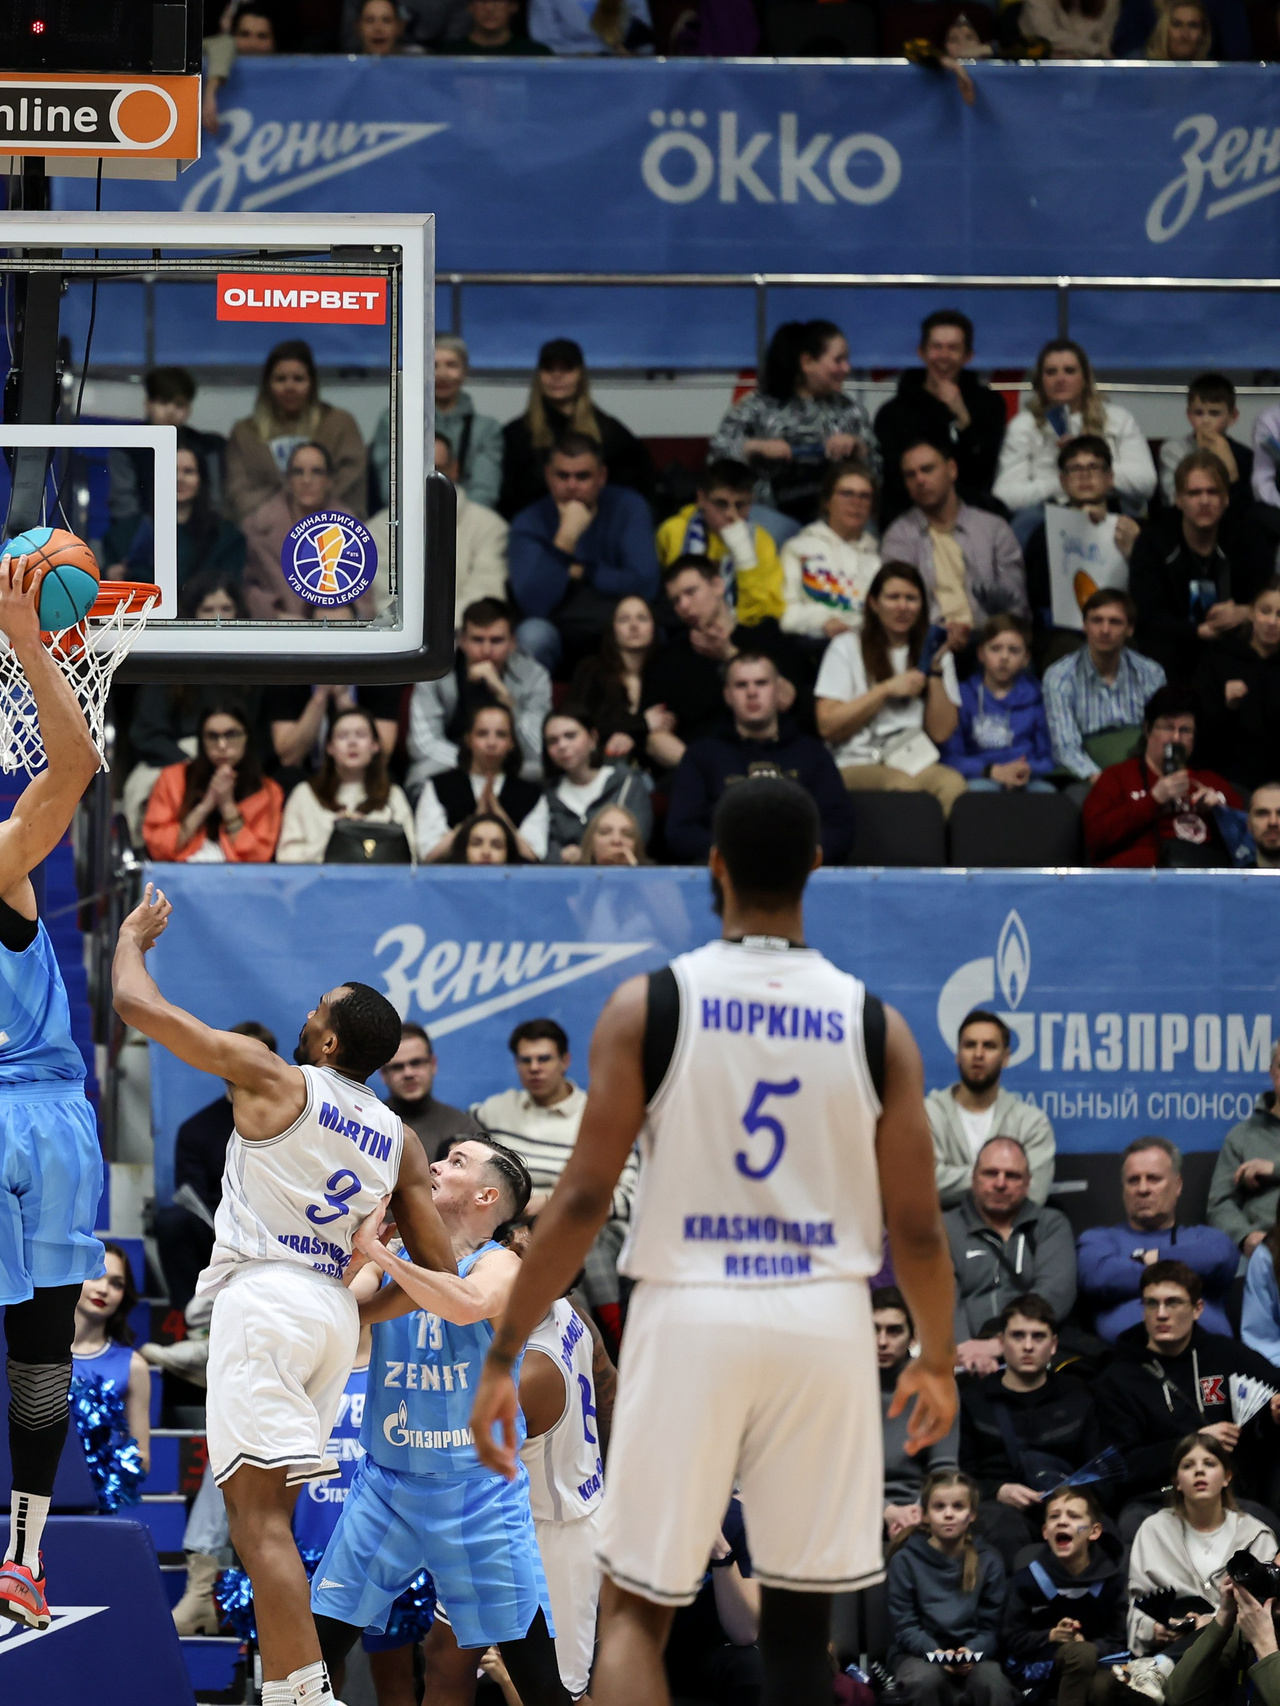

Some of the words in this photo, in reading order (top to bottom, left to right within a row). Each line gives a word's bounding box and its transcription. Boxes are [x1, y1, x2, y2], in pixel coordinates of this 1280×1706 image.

[223, 288, 380, 311] OLIMPBET
[290, 513, 328, 540] ЕДИНАЯ
[329, 513, 355, 529] ЛИГА
[354, 525, 370, 543] ВТБ
[288, 573, 302, 592] VTB
[300, 588, 335, 605] UNITED
[336, 577, 370, 605] LEAGUE
[701, 998, 846, 1044] HOPKINS
[1039, 1011, 1273, 1073] ГАЗПРОМ
[1147, 1091, 1261, 1120] СПОНСО
[318, 1101, 393, 1163] MARTIN
[734, 1076, 802, 1180] 5
[305, 1168, 362, 1226] 3
[725, 1252, 812, 1278] REGION
[416, 1310, 444, 1350] 13
[384, 1360, 471, 1391] ZENIT
[1200, 1375, 1226, 1406] K
